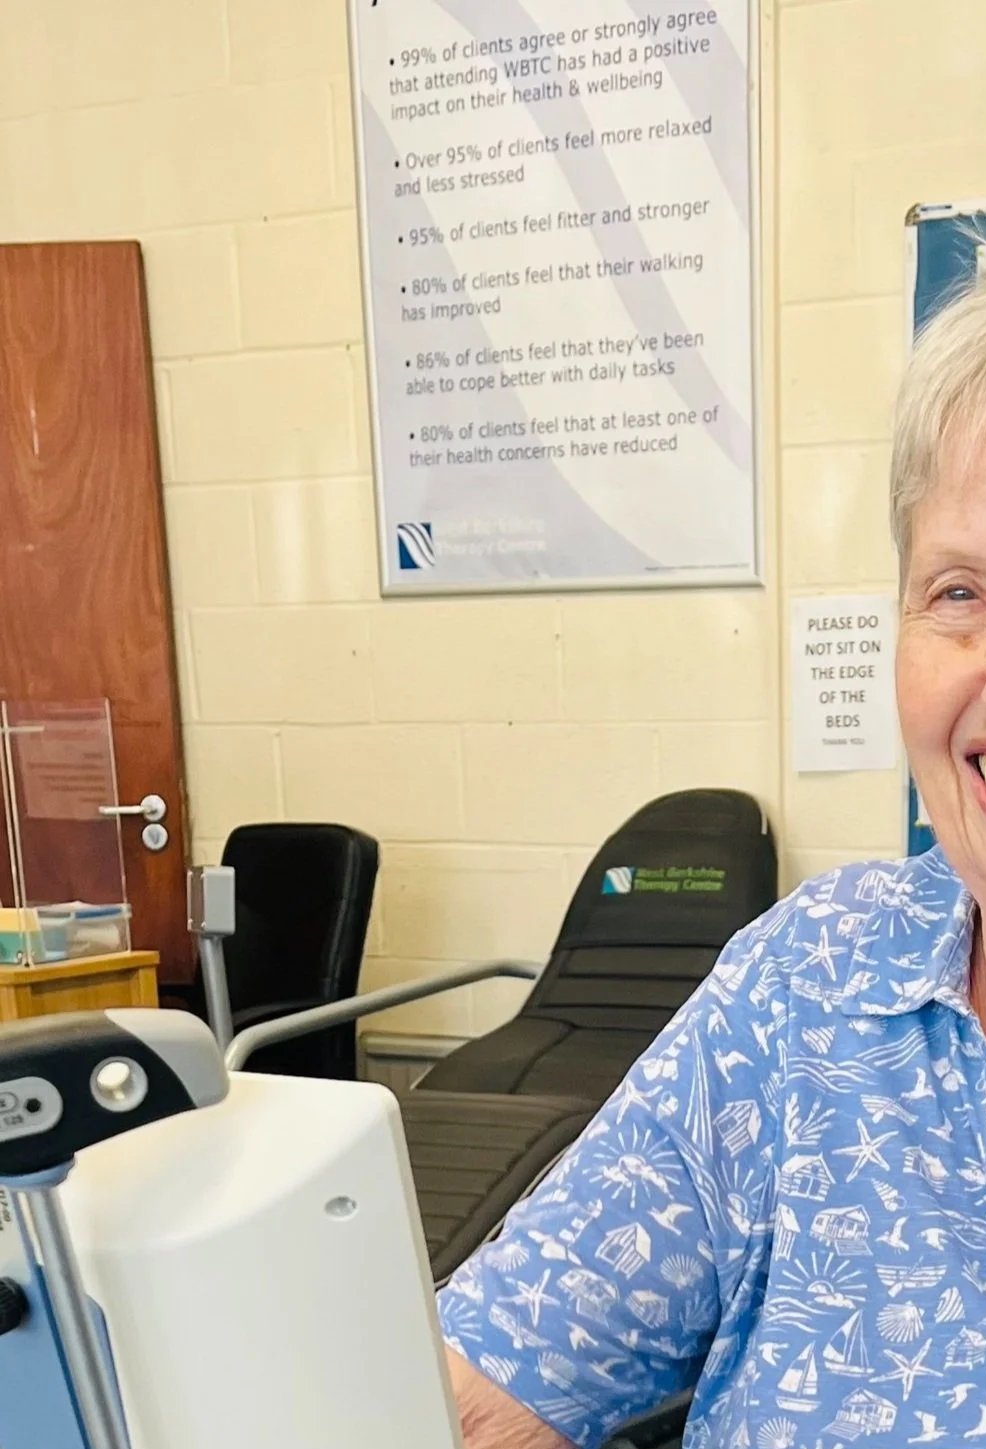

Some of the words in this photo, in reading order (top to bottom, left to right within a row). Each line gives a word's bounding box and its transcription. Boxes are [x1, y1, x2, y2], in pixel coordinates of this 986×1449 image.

[400, 48, 437, 68] 99%
[442, 42, 457, 62] of
[462, 38, 514, 58] clients
[519, 32, 566, 54] agree
[571, 29, 589, 44] or
[594, 15, 661, 40] strongly
[666, 9, 718, 34] agree
[388, 76, 420, 96] that
[423, 66, 499, 90] attending
[502, 56, 553, 78] WBTC
[556, 54, 587, 72] has
[591, 46, 623, 67] had
[627, 48, 639, 63] a
[643, 36, 712, 61] positive
[390, 100, 441, 121] impact
[445, 98, 466, 113] on
[469, 89, 508, 110] their
[511, 81, 564, 103] health
[586, 71, 664, 94] wellbeing
[405, 153, 442, 170] Over
[446, 145, 482, 165] 95%
[487, 140, 503, 160] of
[507, 136, 560, 157] clients
[564, 129, 595, 149] feel
[600, 128, 643, 145] more
[648, 115, 712, 139] relaxed
[393, 177, 422, 197] and
[425, 176, 456, 192] less
[459, 164, 526, 189] stressed
[408, 226, 445, 246] 95%
[449, 223, 465, 242] of
[468, 220, 519, 239] clients
[522, 214, 553, 232] feel
[556, 212, 598, 229] fitter
[601, 205, 633, 224] and
[636, 200, 711, 221] stronger
[411, 278, 448, 296] 80%
[451, 274, 468, 292] of
[471, 271, 521, 290] clients
[524, 265, 554, 284] feel
[557, 262, 592, 281] that
[595, 258, 636, 278] their
[639, 254, 704, 272] walking
[402, 306, 425, 321] has
[431, 297, 502, 321] improved
[415, 352, 451, 370] 86%
[454, 348, 472, 366] of
[474, 347, 525, 365] clients
[527, 342, 557, 360] feel
[560, 340, 595, 357] that
[662, 332, 705, 349] been
[405, 378, 436, 395] able
[438, 378, 456, 392] to
[458, 376, 496, 392] cope
[499, 371, 547, 388] better
[550, 364, 585, 383] with
[588, 362, 628, 382] daily
[631, 358, 676, 377] tasks
[419, 425, 455, 442] 80%
[458, 422, 475, 440] of
[477, 422, 527, 439] clients
[529, 417, 560, 434] feel
[563, 416, 597, 432] that
[600, 414, 618, 430] at
[621, 411, 662, 429] least
[666, 411, 699, 426] one
[701, 405, 720, 423] of
[409, 451, 443, 467] their
[445, 446, 494, 464] health
[497, 445, 566, 461] concerns
[569, 440, 609, 456] have
[612, 434, 678, 454] reduced
[807, 617, 853, 632] PLEASE
[857, 615, 879, 630] DO
[804, 642, 832, 656] NOT
[836, 641, 855, 655] SIT
[859, 640, 881, 654] ON
[811, 667, 835, 680] THE
[839, 665, 875, 679] EDGE
[819, 691, 836, 704] OF
[840, 690, 866, 703] THE
[826, 714, 860, 728] BEDS
